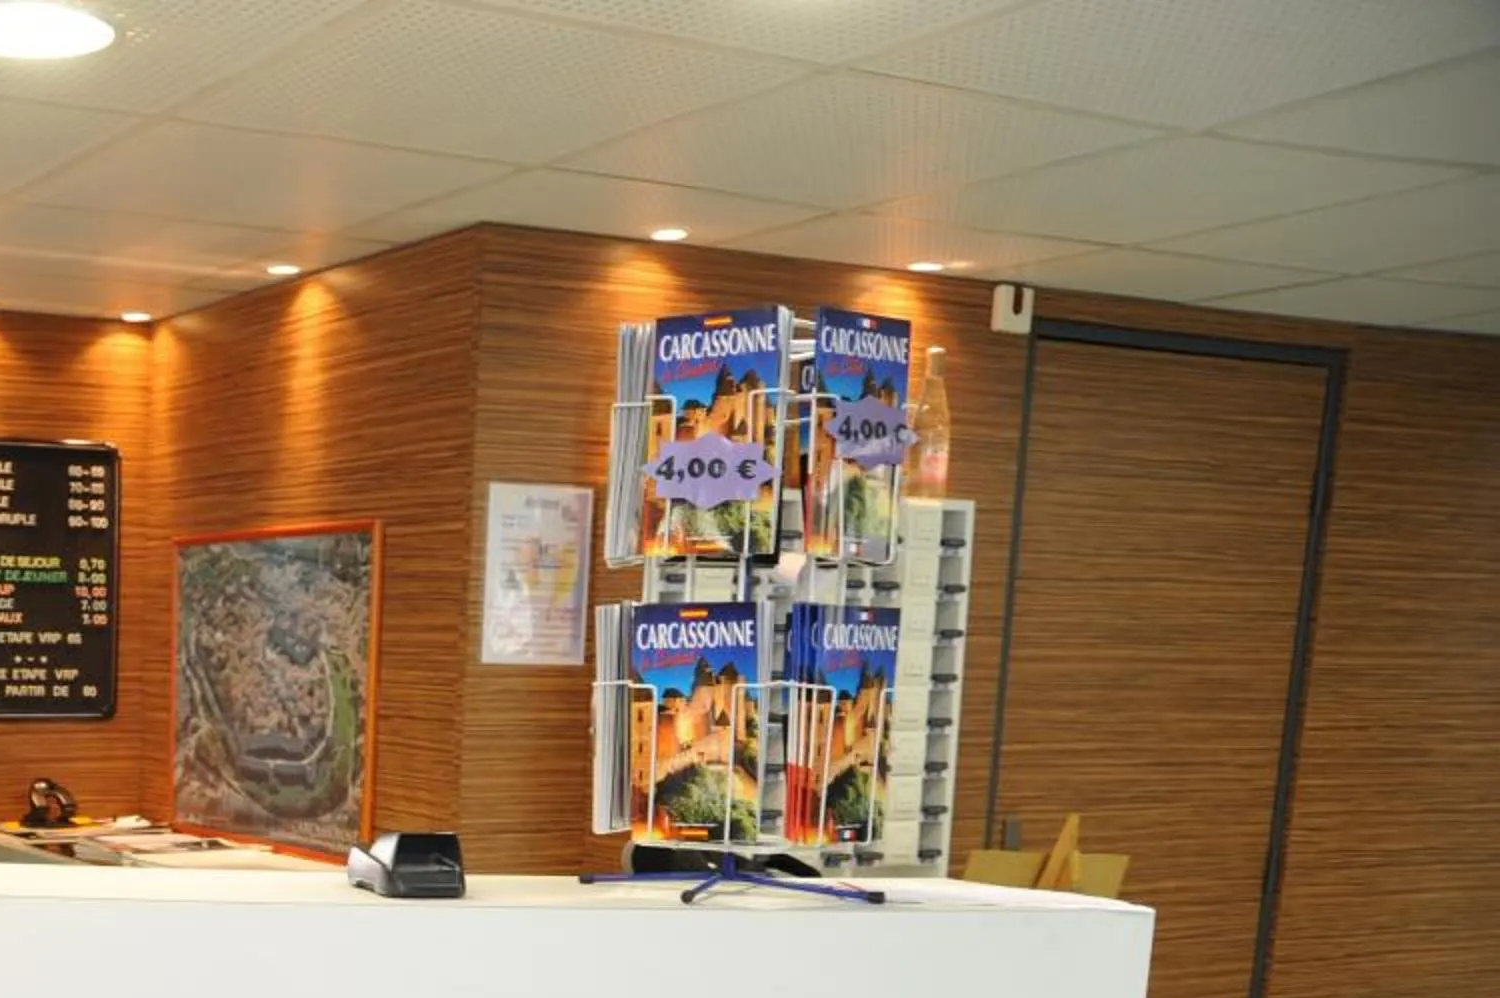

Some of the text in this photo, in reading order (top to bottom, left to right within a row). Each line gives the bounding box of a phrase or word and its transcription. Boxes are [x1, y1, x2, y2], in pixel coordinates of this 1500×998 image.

[659, 323, 777, 362] CARCASSONNE
[821, 325, 909, 364] CARCASSONNE
[839, 415, 888, 443] 4,00
[655, 456, 757, 481] 4,00 €
[0, 555, 13, 568] DE
[16, 555, 61, 569] SEJOUR
[37, 631, 63, 645] VRP
[636, 619, 755, 651] CARCASSONNE
[823, 622, 898, 651] CARCASSONNE
[11, 667, 47, 681] ETAPE
[53, 668, 80, 681] VRP
[4, 684, 45, 698] PARTIR
[52, 685, 70, 698] DE
